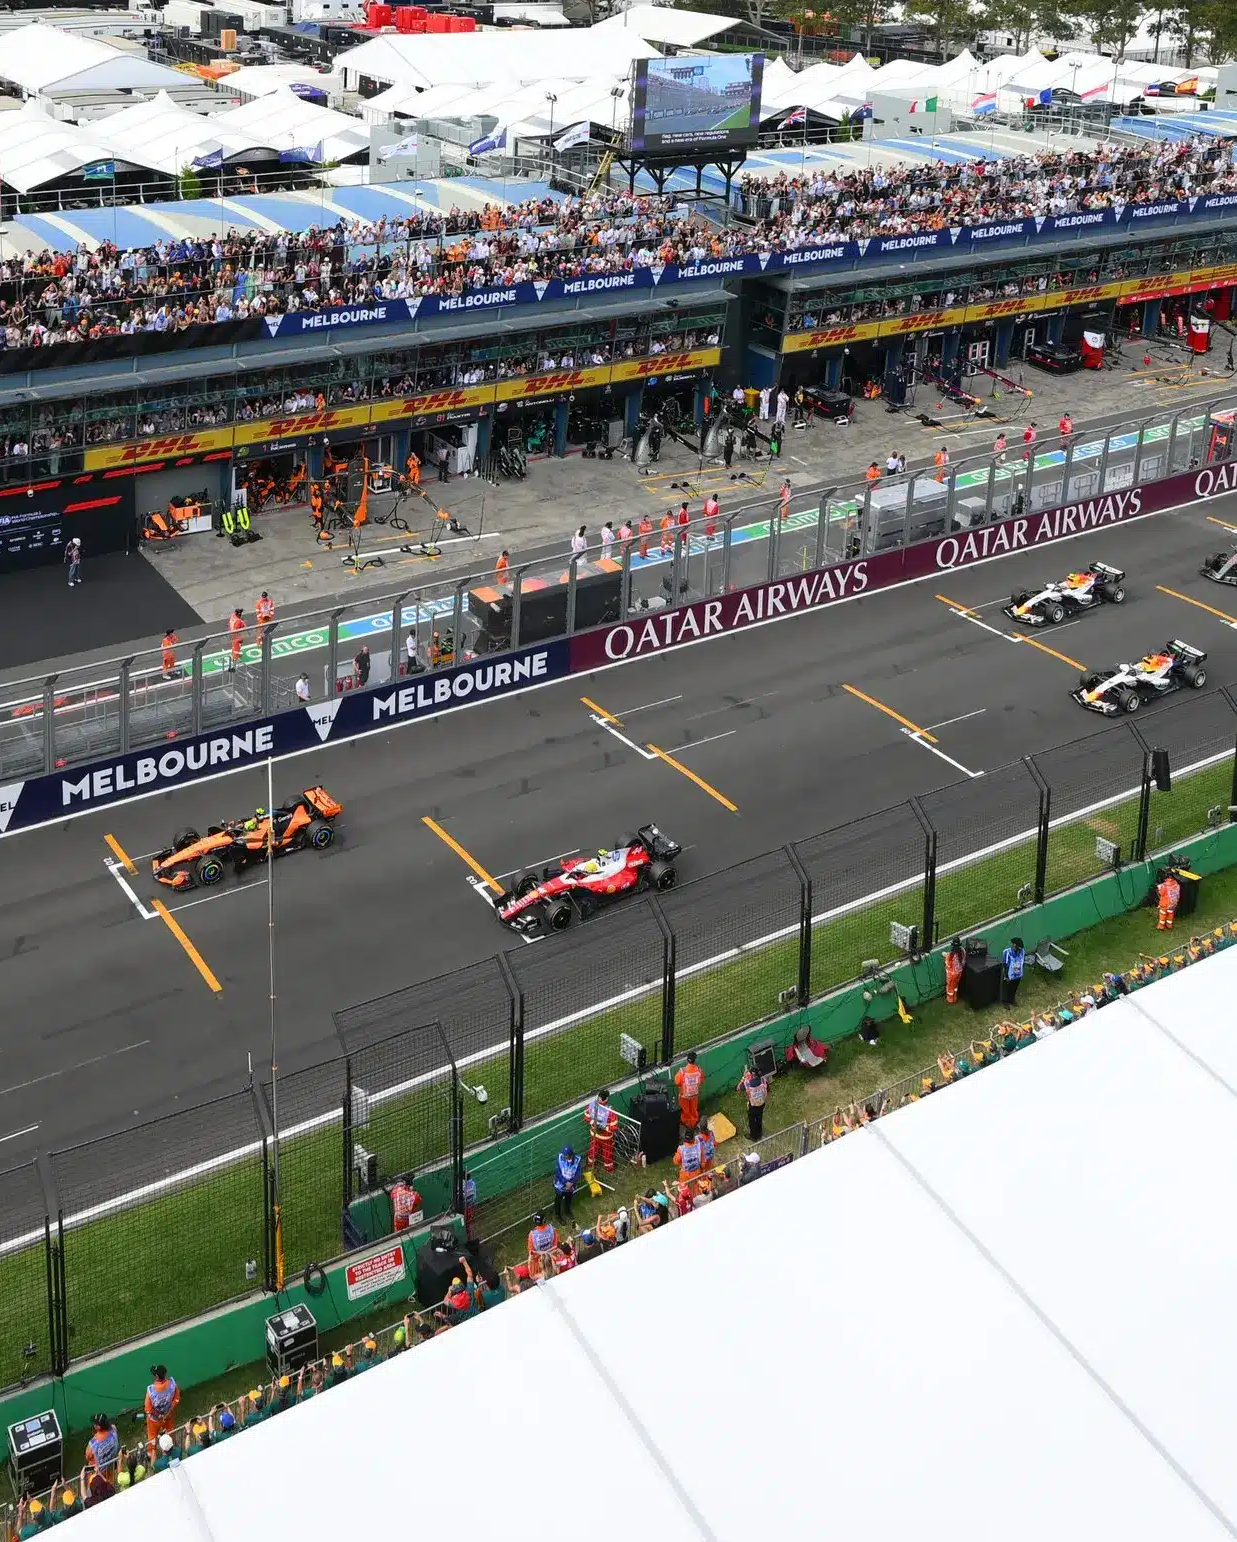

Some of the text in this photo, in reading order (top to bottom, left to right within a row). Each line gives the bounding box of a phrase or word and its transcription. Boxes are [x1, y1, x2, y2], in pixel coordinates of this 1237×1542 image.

[1133, 203, 1178, 218] MELBOURNE
[1054, 213, 1103, 228] MELBOURNE
[971, 224, 1023, 239] MELBOURNE
[881, 234, 937, 251] MELBOURNE
[783, 247, 844, 265] MELBOURNE
[678, 260, 743, 279] MELBOURNE
[563, 274, 635, 294] MELBOURNE
[1138, 275, 1175, 290] DHL
[439, 290, 516, 310] MELBOURNE
[1064, 286, 1102, 302] DHL
[985, 299, 1028, 316] DHL
[302, 307, 387, 328] MELBOURNE
[899, 312, 945, 330] DHL
[809, 326, 858, 345] DHL
[636, 354, 693, 375] DHL
[524, 371, 585, 392] DHL
[401, 390, 467, 413] DHL
[267, 412, 339, 436] DHL
[121, 434, 200, 461] DHL
[935, 489, 1142, 568] QATAR AIRWAYS
[604, 562, 868, 659] QATAR AIRWAYS
[373, 652, 548, 721] MELBOURNE
[313, 716, 334, 726] MEL
[62, 725, 273, 804] MELBOURNE
